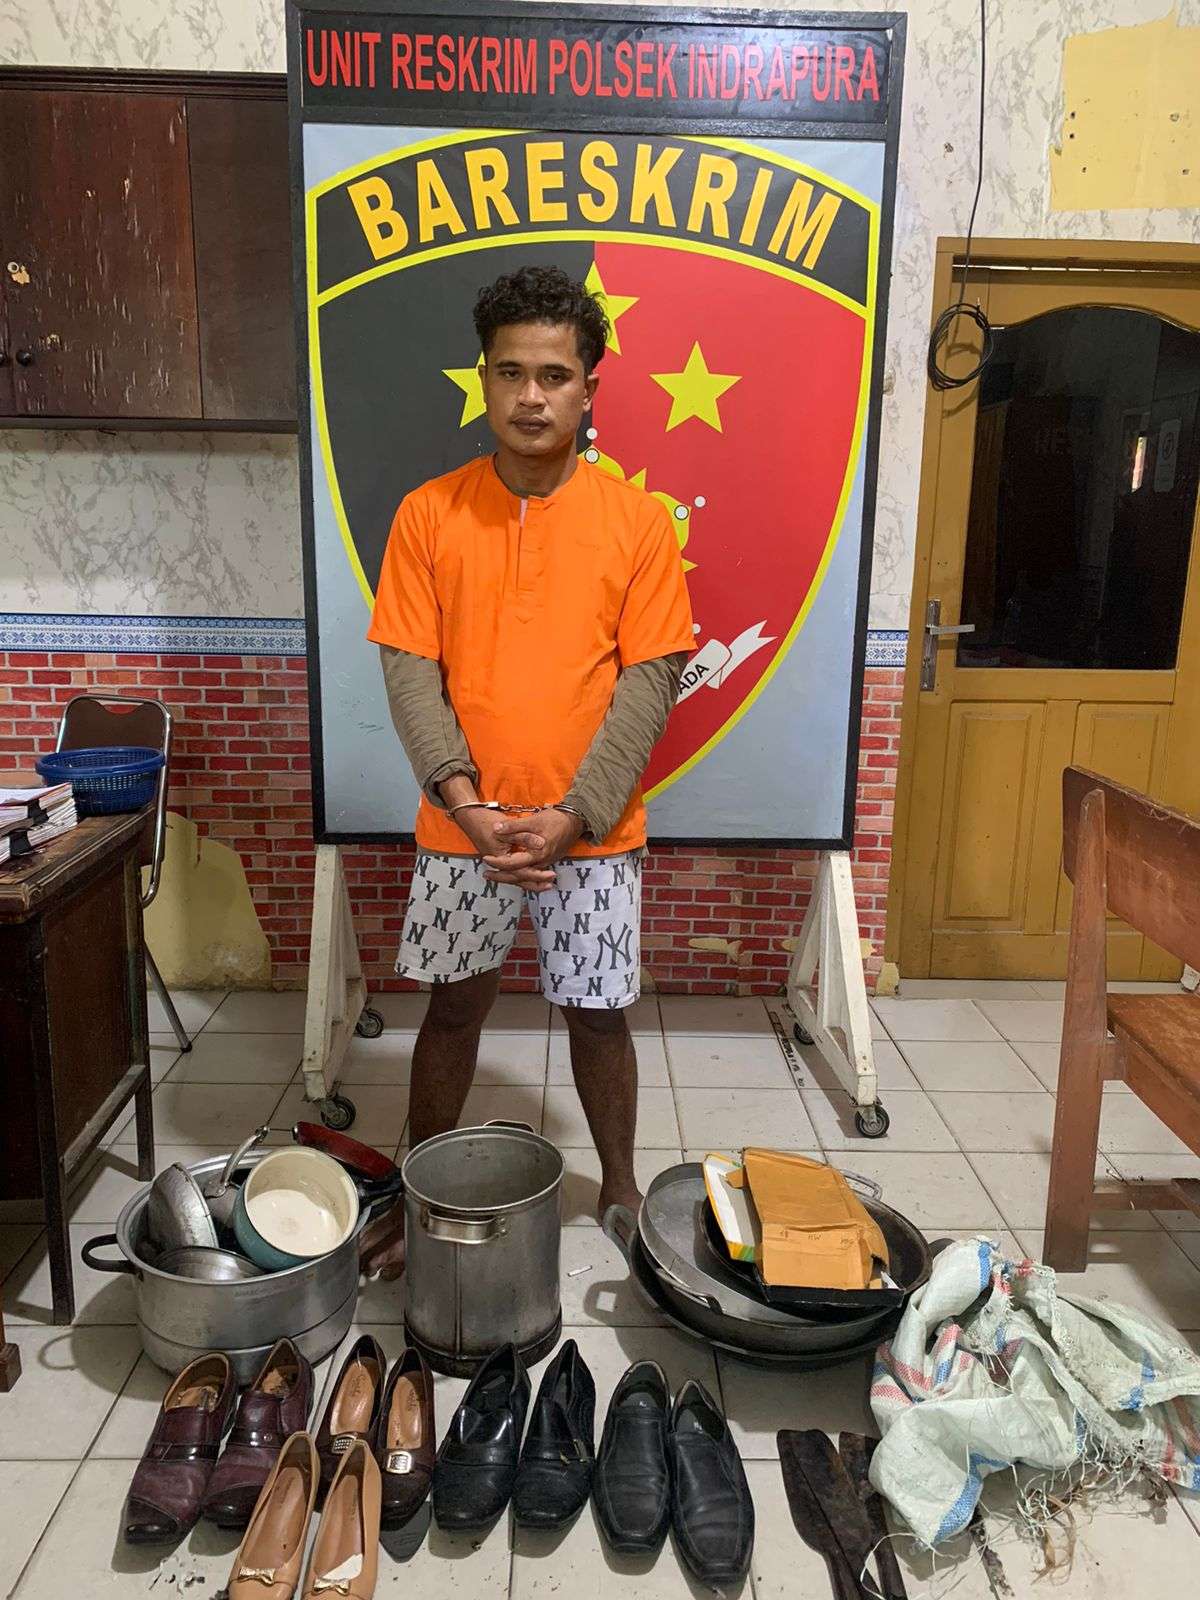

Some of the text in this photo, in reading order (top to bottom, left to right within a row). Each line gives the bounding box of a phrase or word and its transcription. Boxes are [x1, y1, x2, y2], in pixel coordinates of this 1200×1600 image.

[307, 29, 880, 101] UNIT RESKRIM POLSEK INDRAPURA
[347, 140, 842, 270] BARESKRIM
